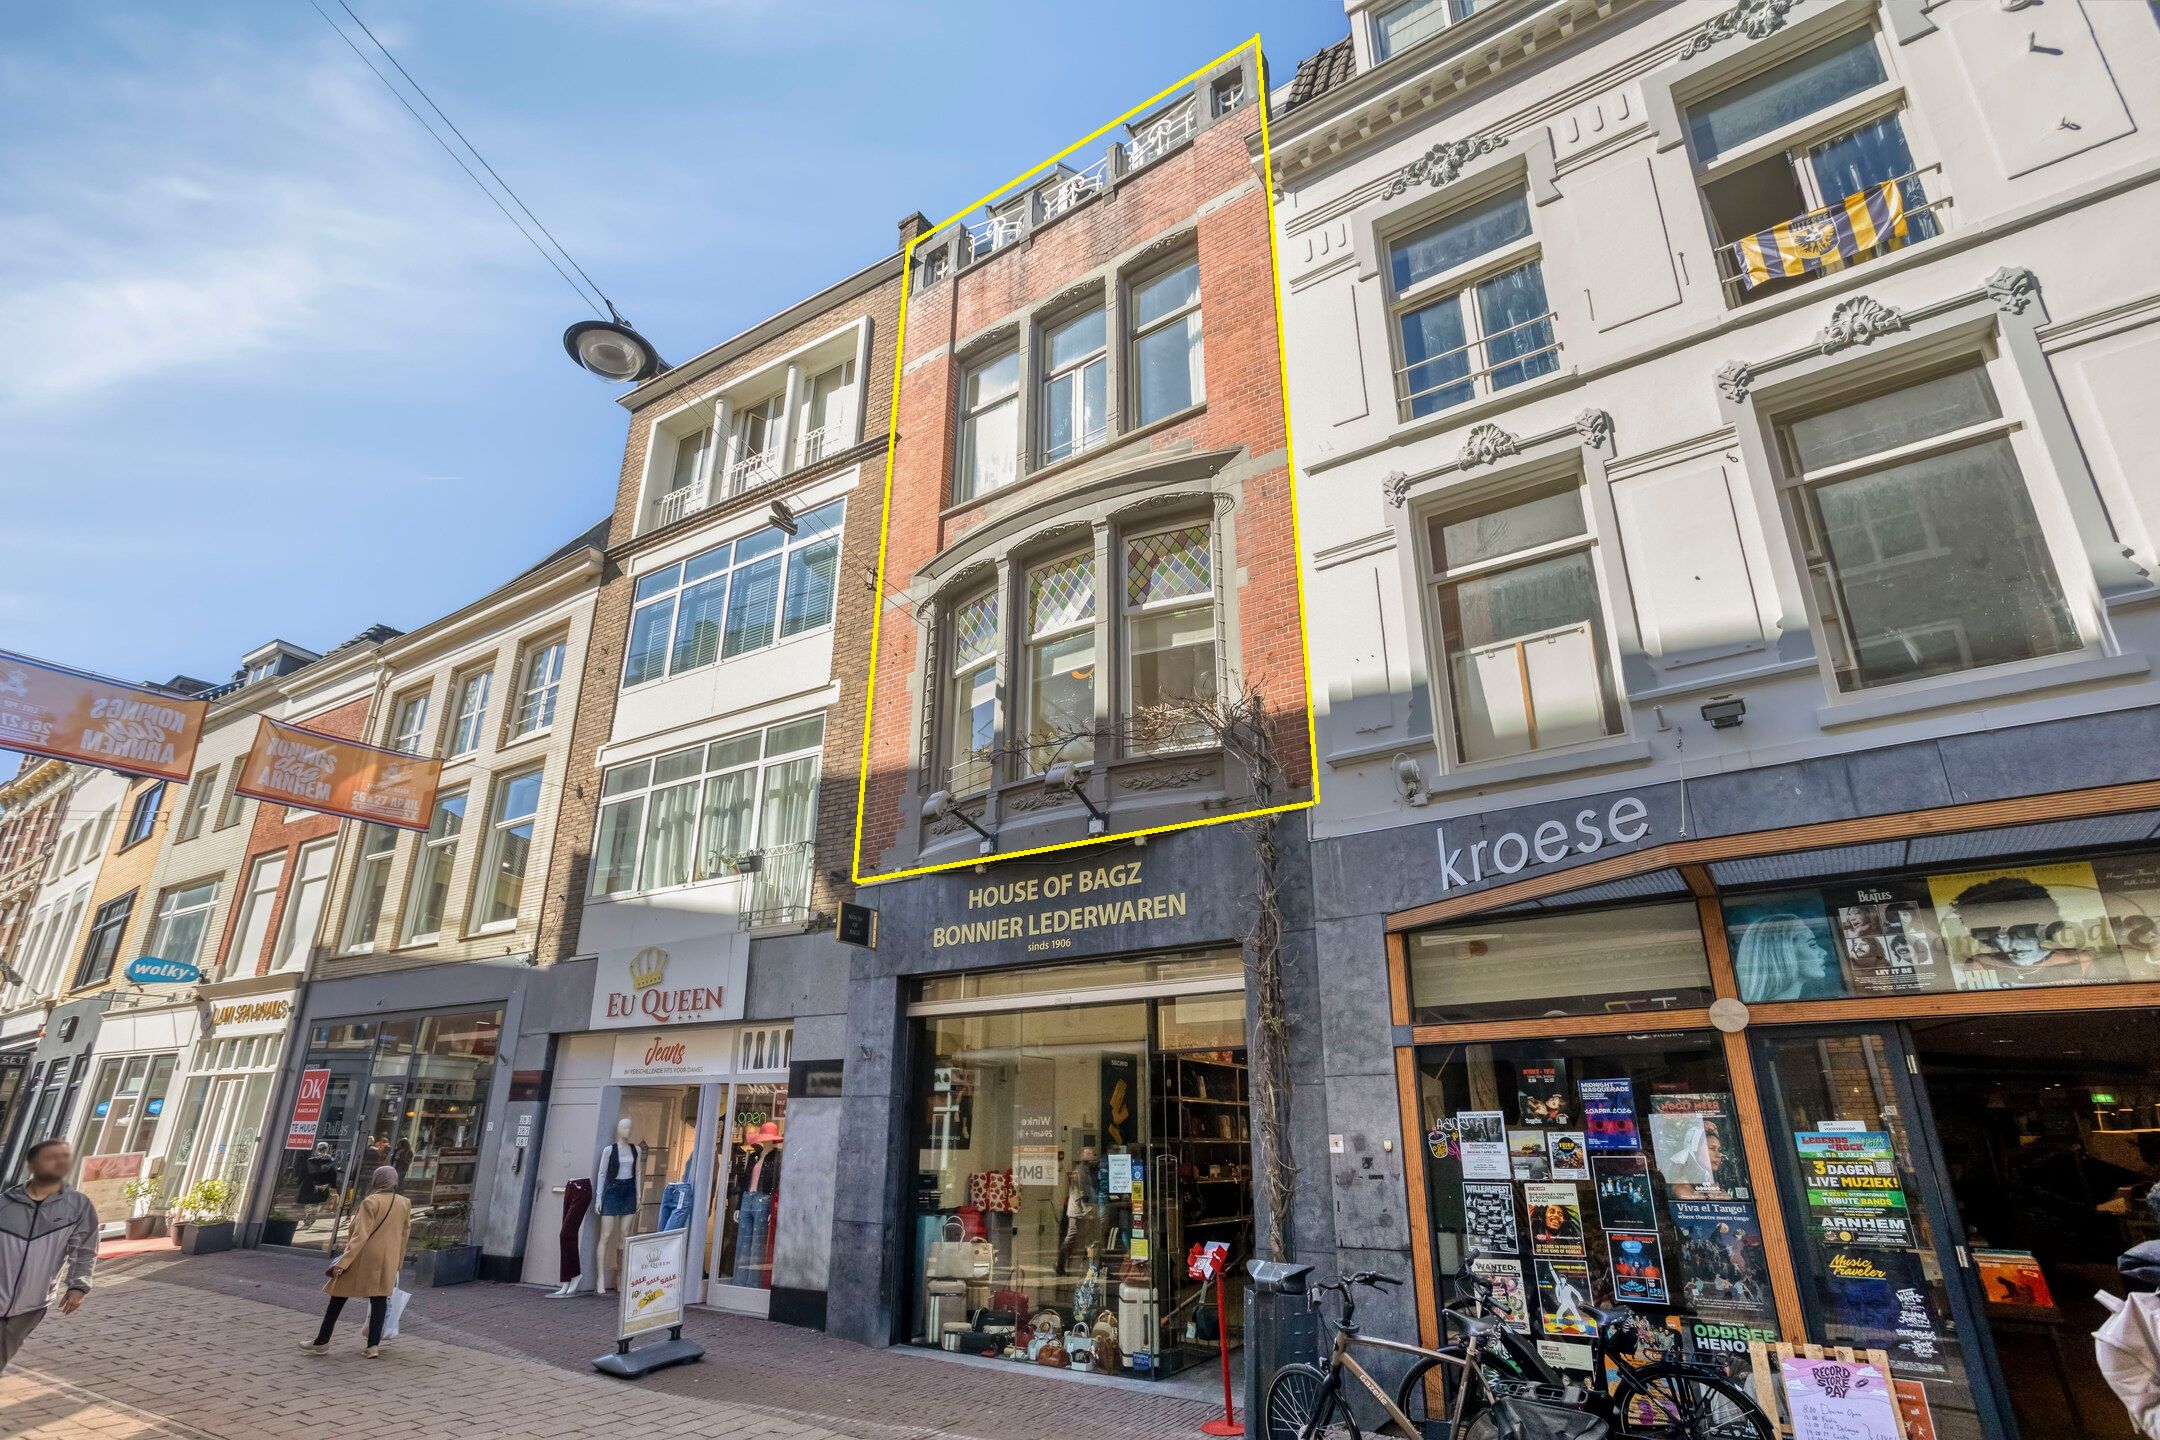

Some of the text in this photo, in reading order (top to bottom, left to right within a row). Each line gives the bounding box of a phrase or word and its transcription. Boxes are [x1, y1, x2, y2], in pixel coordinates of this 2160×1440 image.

[257, 765, 332, 801] ARNHEM
[352, 790, 367, 802] 26
[374, 795, 388, 806] 27
[1436, 797, 1648, 891] kroese
[968, 861, 1143, 910] HOUSE OF BAGZ
[1857, 890, 1892, 903] BEATLES
[933, 892, 1187, 948] BONNIER LEDERWAREN
[1027, 937, 1072, 953] sinds 1906
[134, 963, 189, 980] wolky
[606, 985, 724, 1024] EU QUEEN
[644, 1036, 686, 1067] Jeans
[301, 1078, 325, 1099] DK
[1580, 1081, 1614, 1089] MIDNIGHT
[737, 1111, 767, 1126] open
[291, 1122, 317, 1133] TE HUUR
[1801, 1136, 1848, 1145] LEGENDS
[1836, 1143, 1865, 1151] ROCK
[1813, 1160, 1875, 1176] 3 DAGEN
[1807, 1176, 1899, 1188] LIVE MUZIEK!
[1465, 1185, 1510, 1195] WILLEMSFEST
[1821, 1197, 1893, 1206] TRIBUTE BANDS
[1676, 1203, 1747, 1215] Viva el Tango!
[1821, 1217, 1906, 1229] ARNHEM
[1476, 1263, 1517, 1271] WANTED:
[1829, 1254, 1873, 1269] Music
[1833, 1264, 1887, 1278] Traveler
[630, 1275, 647, 1287] SALE
[660, 1273, 677, 1285] SALE
[1693, 1323, 1776, 1343] ODDISEE
[1812, 1365, 1851, 1380] RECORD
[1816, 1376, 1851, 1389] STORE
[1825, 1385, 1850, 1399] DAY
